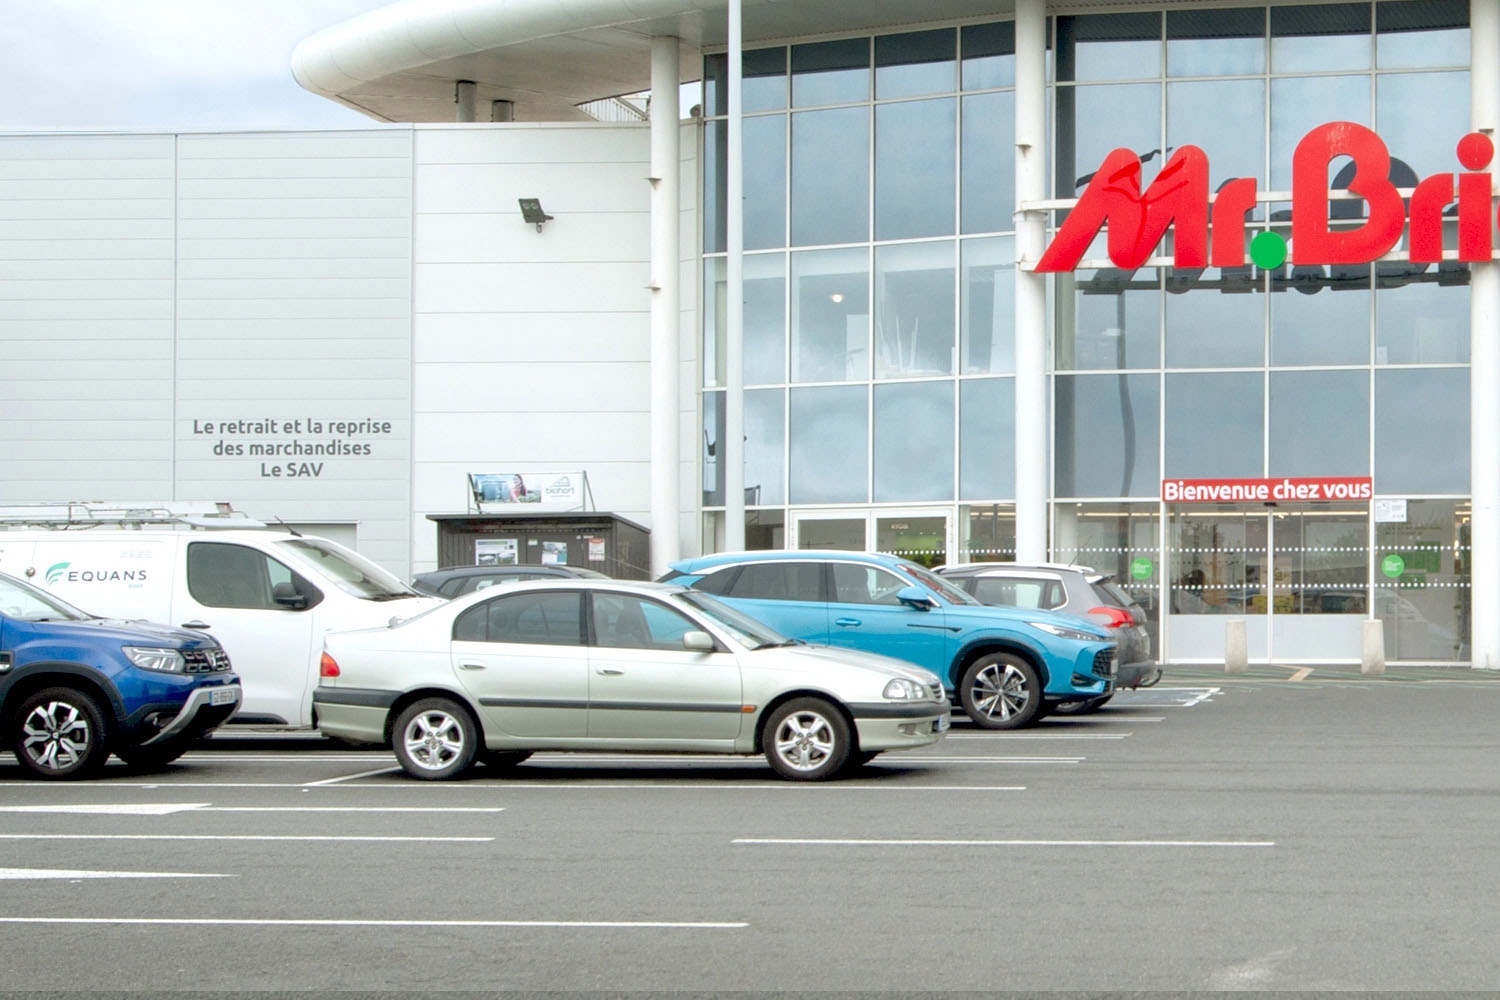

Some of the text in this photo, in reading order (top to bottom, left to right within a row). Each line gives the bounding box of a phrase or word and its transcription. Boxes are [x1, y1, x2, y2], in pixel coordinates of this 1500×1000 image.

[193, 418, 392, 437] Le retrait et la reprise
[213, 440, 371, 455] des marchandises
[260, 462, 324, 477] Le SAV
[1164, 479, 1371, 500] Bienvenue chez vous
[68, 570, 147, 582] EQUANS
